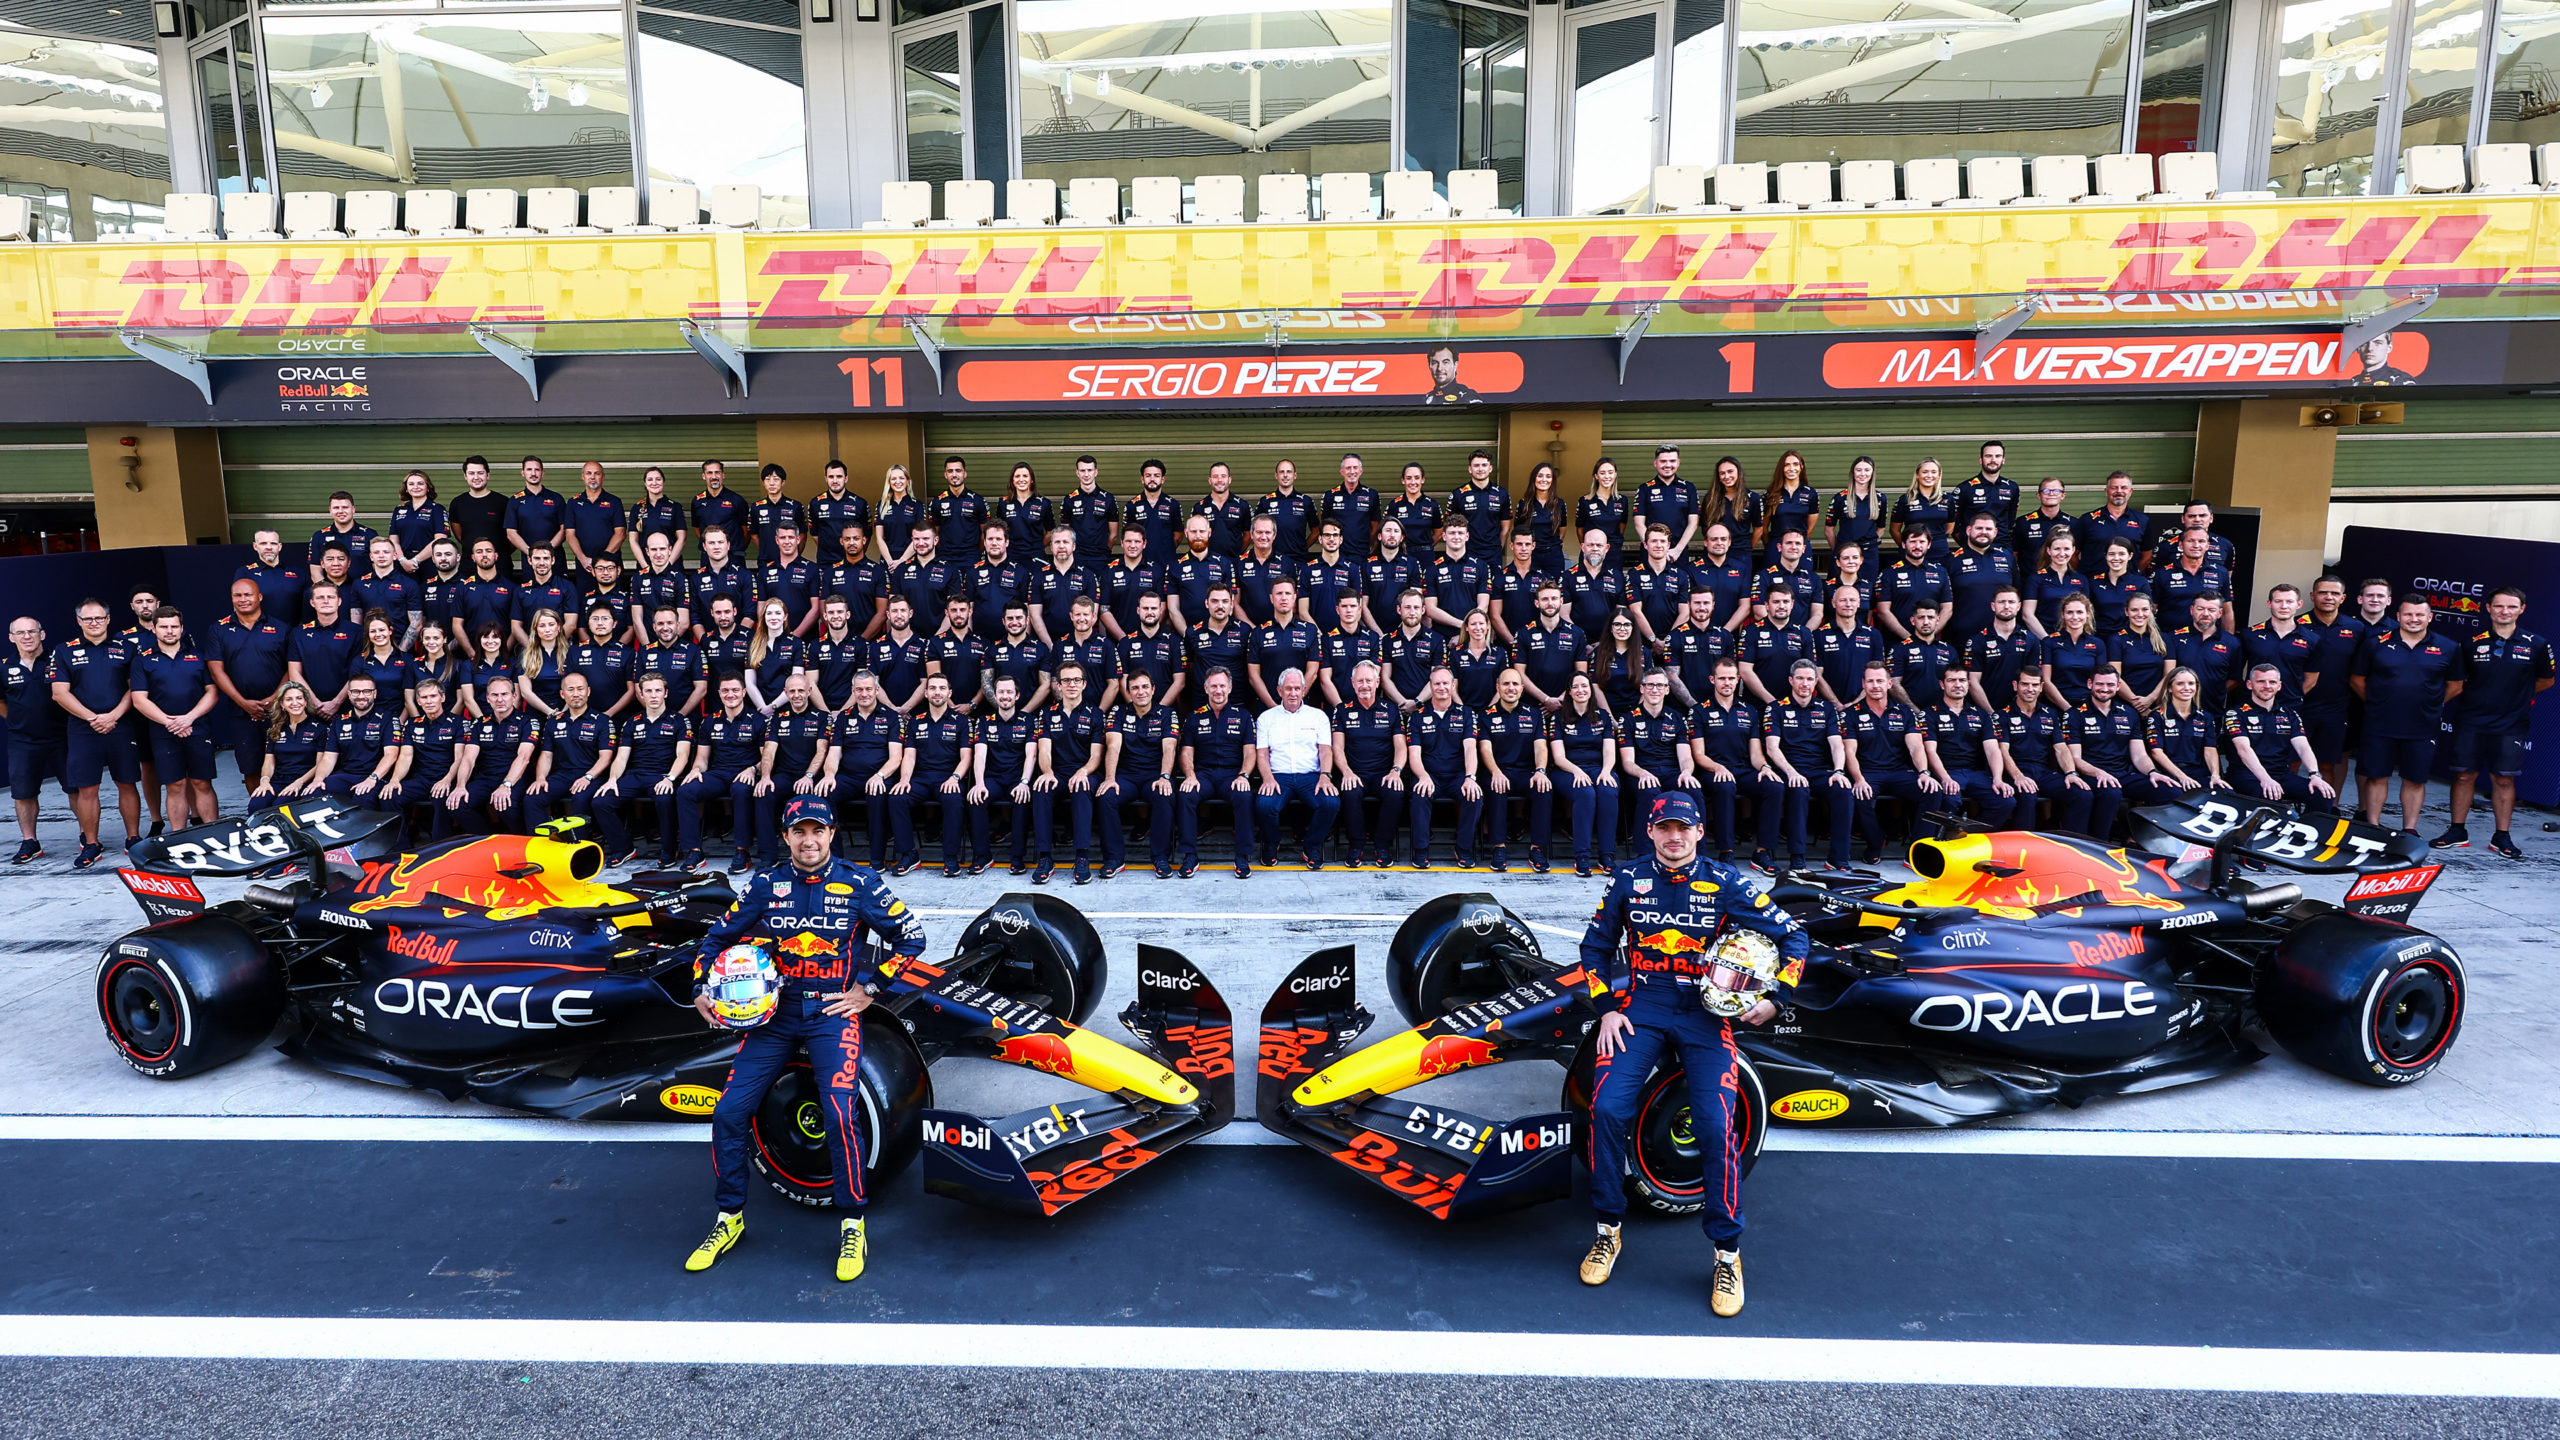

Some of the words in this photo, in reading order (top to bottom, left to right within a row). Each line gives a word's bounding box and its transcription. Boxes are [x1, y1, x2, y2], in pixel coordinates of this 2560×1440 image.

[2100, 215, 2511, 300] DHL
[1410, 233, 1797, 318] DHL
[119, 257, 477, 336] DHL
[755, 247, 1122, 329] DHL
[1718, 342, 1755, 393] 1
[1879, 347, 2009, 383] MAX
[2013, 339, 2341, 381] VERSTAPPEN
[278, 366, 367, 380] ORACLE
[837, 357, 904, 407] 11
[1063, 362, 1228, 397] SERGIO
[1233, 359, 1386, 395] PEREZ
[281, 403, 371, 412] RACING
[2413, 577, 2484, 597] ORACLE
[2435, 614, 2479, 627] CING
[123, 873, 181, 896] Mobil
[2350, 872, 2415, 897] Mobil
[653, 896, 680, 908] Tezos
[824, 896, 850, 906] BYBIT
[1689, 894, 1716, 904] BYBIT
[1827, 896, 1854, 910] Tezos
[2371, 903, 2408, 915] Tezos
[319, 909, 374, 930] HONDA
[770, 916, 849, 930] ORACLE
[1629, 910, 1716, 929] ORACLE
[2160, 910, 2219, 930] HONDA
[529, 928, 575, 950] citrix
[1942, 928, 1991, 951] citrix
[804, 960, 844, 979] Bull
[1632, 951, 1669, 973] Red
[1712, 957, 1754, 976] ORACLE
[1141, 969, 1196, 991] Claro
[1290, 971, 1345, 993] Claro
[374, 977, 606, 1029] ORACLE
[1910, 981, 2158, 1032] ORACLE
[1774, 1025, 1802, 1034] Tezos
[831, 1043, 861, 1090] Red
[1792, 1098, 1839, 1112] RAUCH
[922, 1119, 991, 1150] Mobil
[1404, 1105, 1493, 1153] BYBI
[1500, 1122, 1571, 1155] Mobil
[1650, 1200, 1705, 1213] ERO
